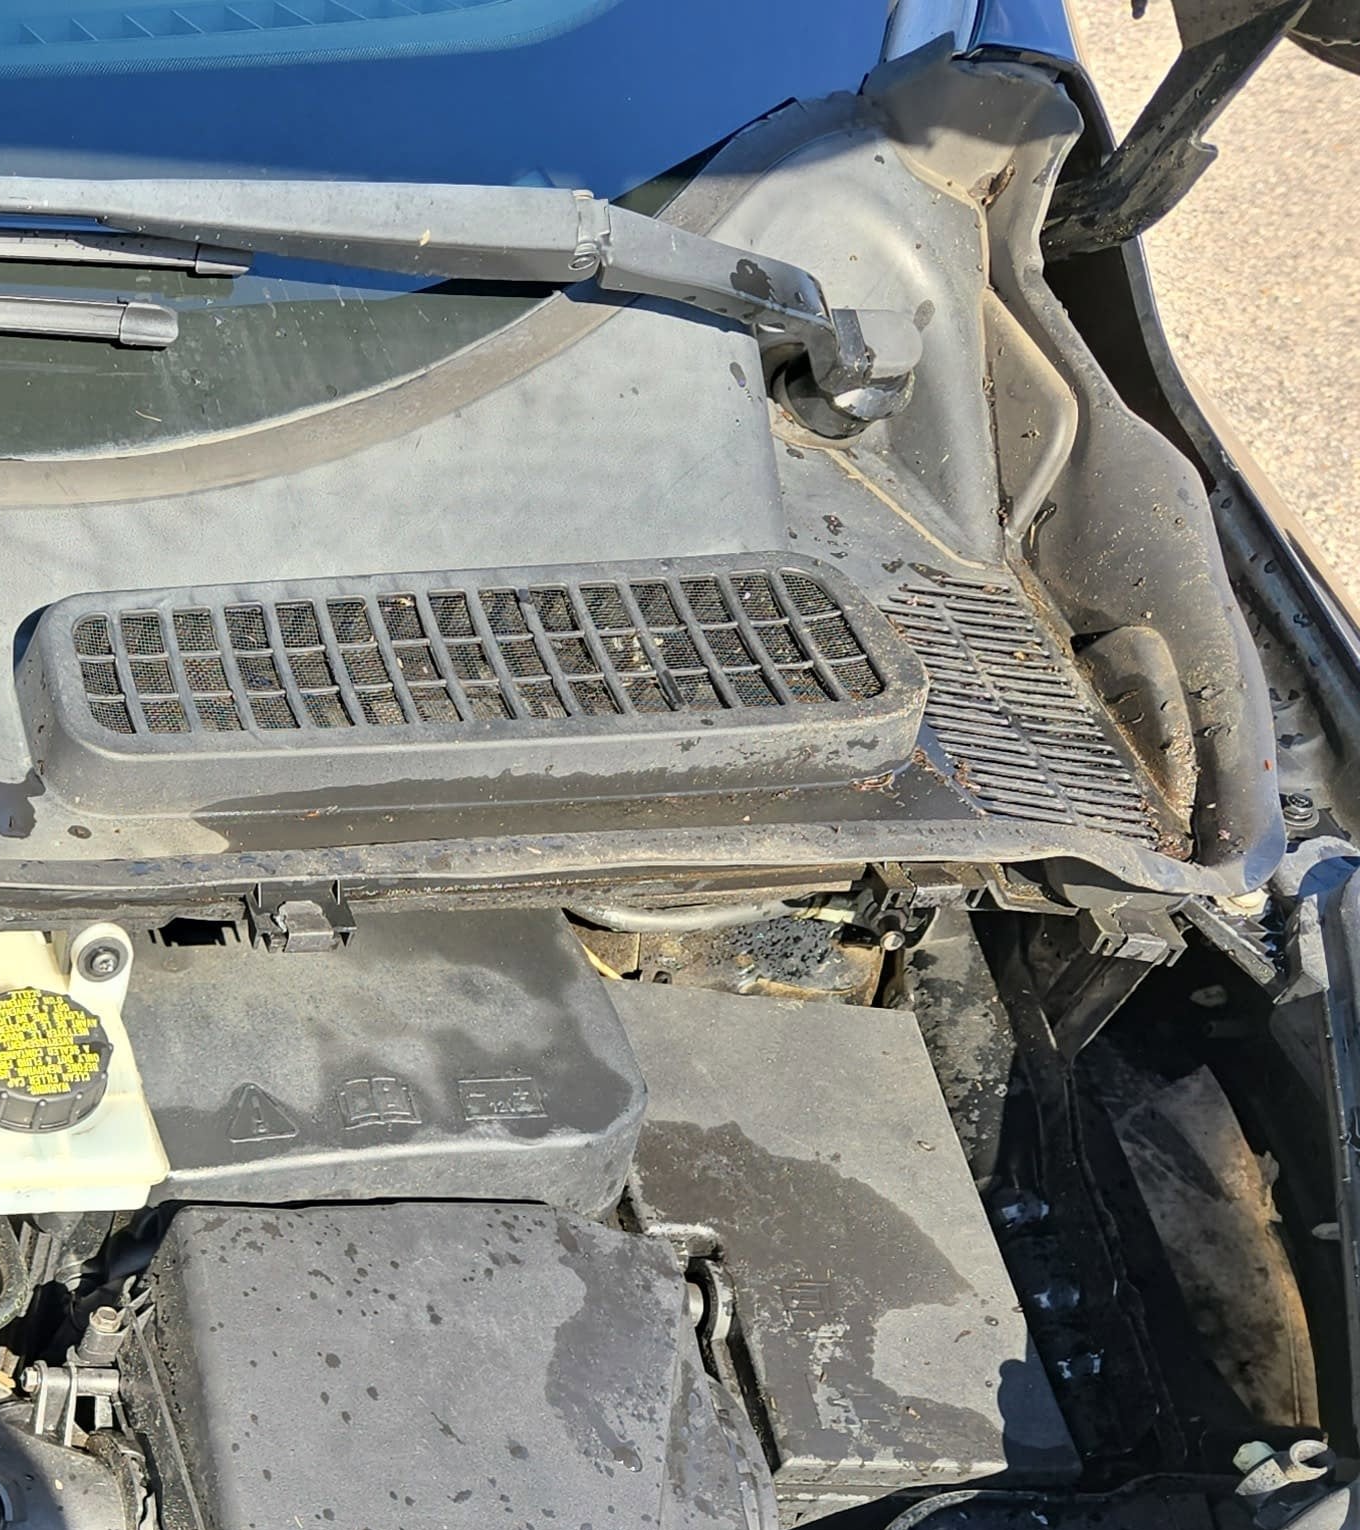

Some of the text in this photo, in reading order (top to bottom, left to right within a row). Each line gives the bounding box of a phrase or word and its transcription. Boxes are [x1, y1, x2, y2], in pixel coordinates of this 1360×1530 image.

[46, 1044, 80, 1056] SEALED
[82, 1044, 90, 1054] A
[16, 1056, 43, 1068] FLUID
[65, 1062, 99, 1073] BEFORE
[7, 1071, 91, 1088] CLEAN FILLER CAP
